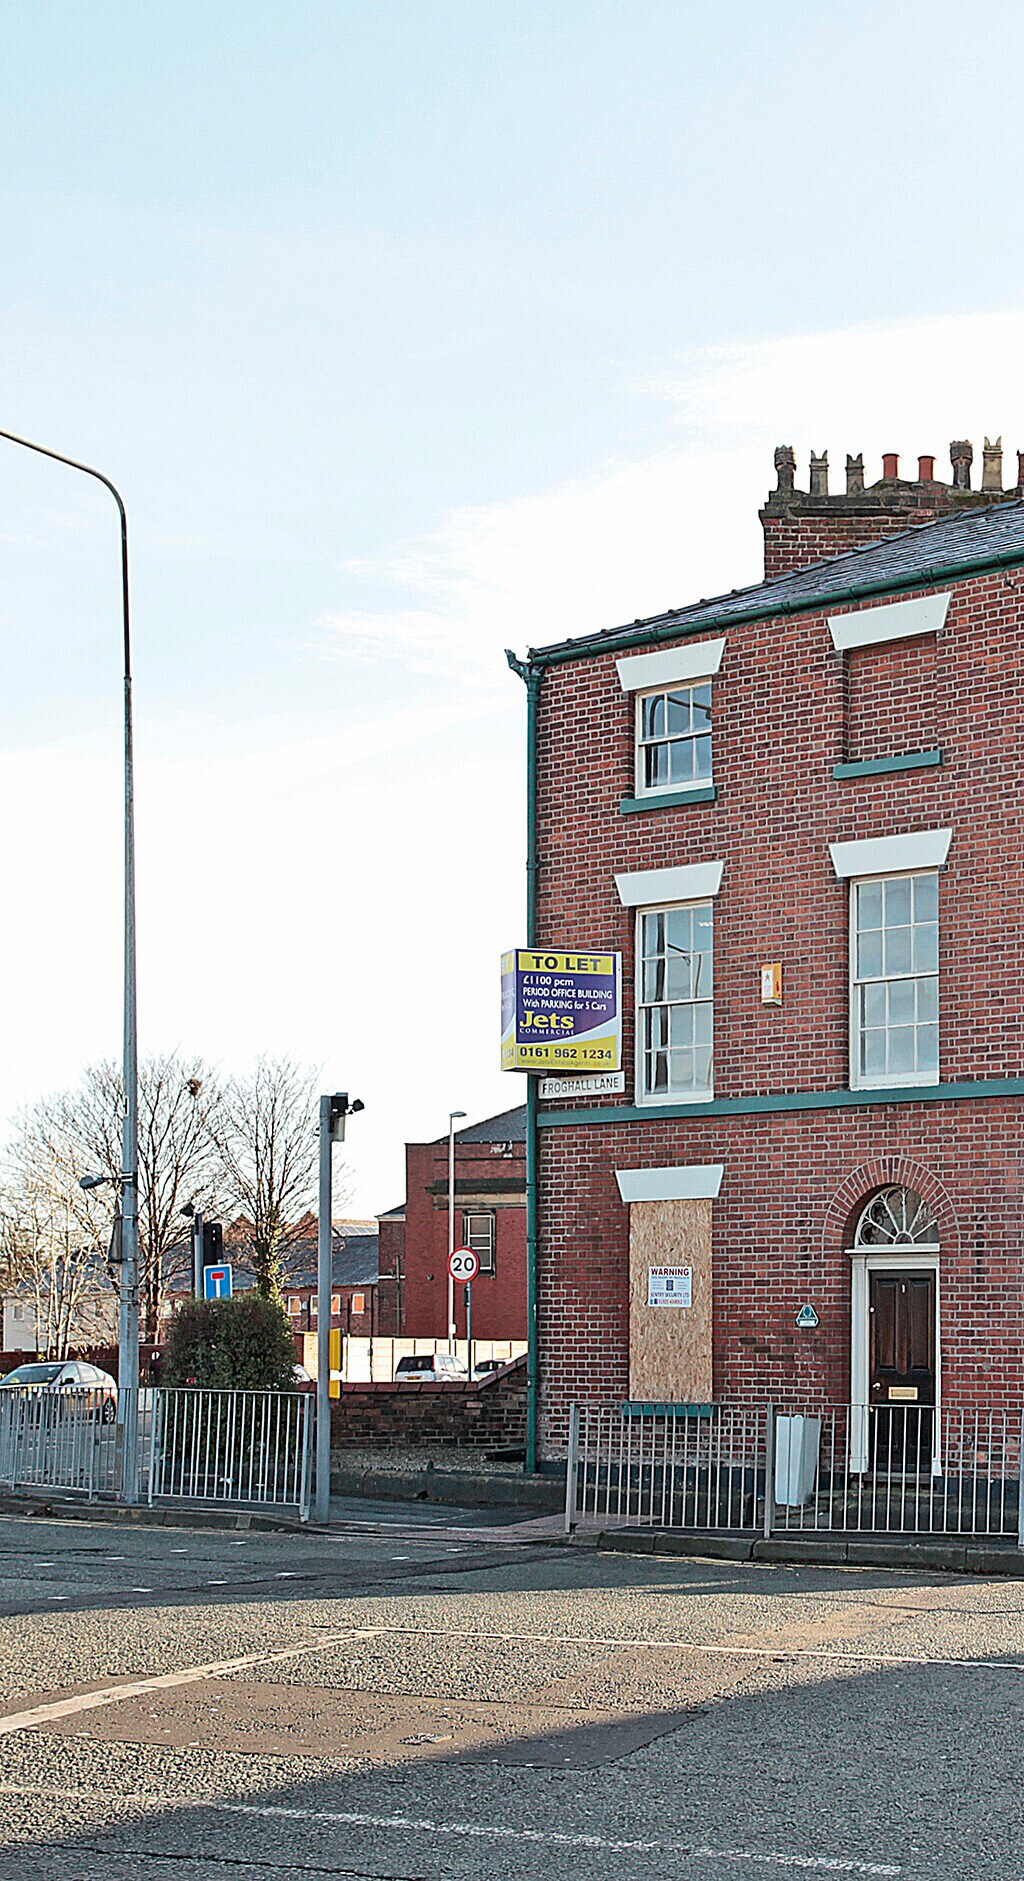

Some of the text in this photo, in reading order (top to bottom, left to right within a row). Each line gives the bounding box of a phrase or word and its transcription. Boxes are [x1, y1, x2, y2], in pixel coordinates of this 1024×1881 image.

[532, 956, 601, 971] TO LET
[523, 975, 574, 987] £1100 pcm
[522, 987, 550, 997] PERIOD
[551, 988, 576, 998] OFFICE
[577, 989, 613, 999] BUILDING
[522, 998, 540, 1008] With
[541, 999, 573, 1009] PARKING
[574, 1000, 584, 1010] for
[585, 1001, 590, 1010] 5
[591, 1001, 607, 1010] Cars
[519, 1010, 575, 1029] Jets
[519, 1027, 575, 1036] COMMERCIAL
[520, 1047, 549, 1058] 0161
[554, 1048, 578, 1059] 962
[582, 1049, 612, 1059] 1234
[542, 1077, 619, 1095] FROGHALL LANE
[452, 1257, 474, 1271] 20
[650, 1268, 689, 1276] WARNING
